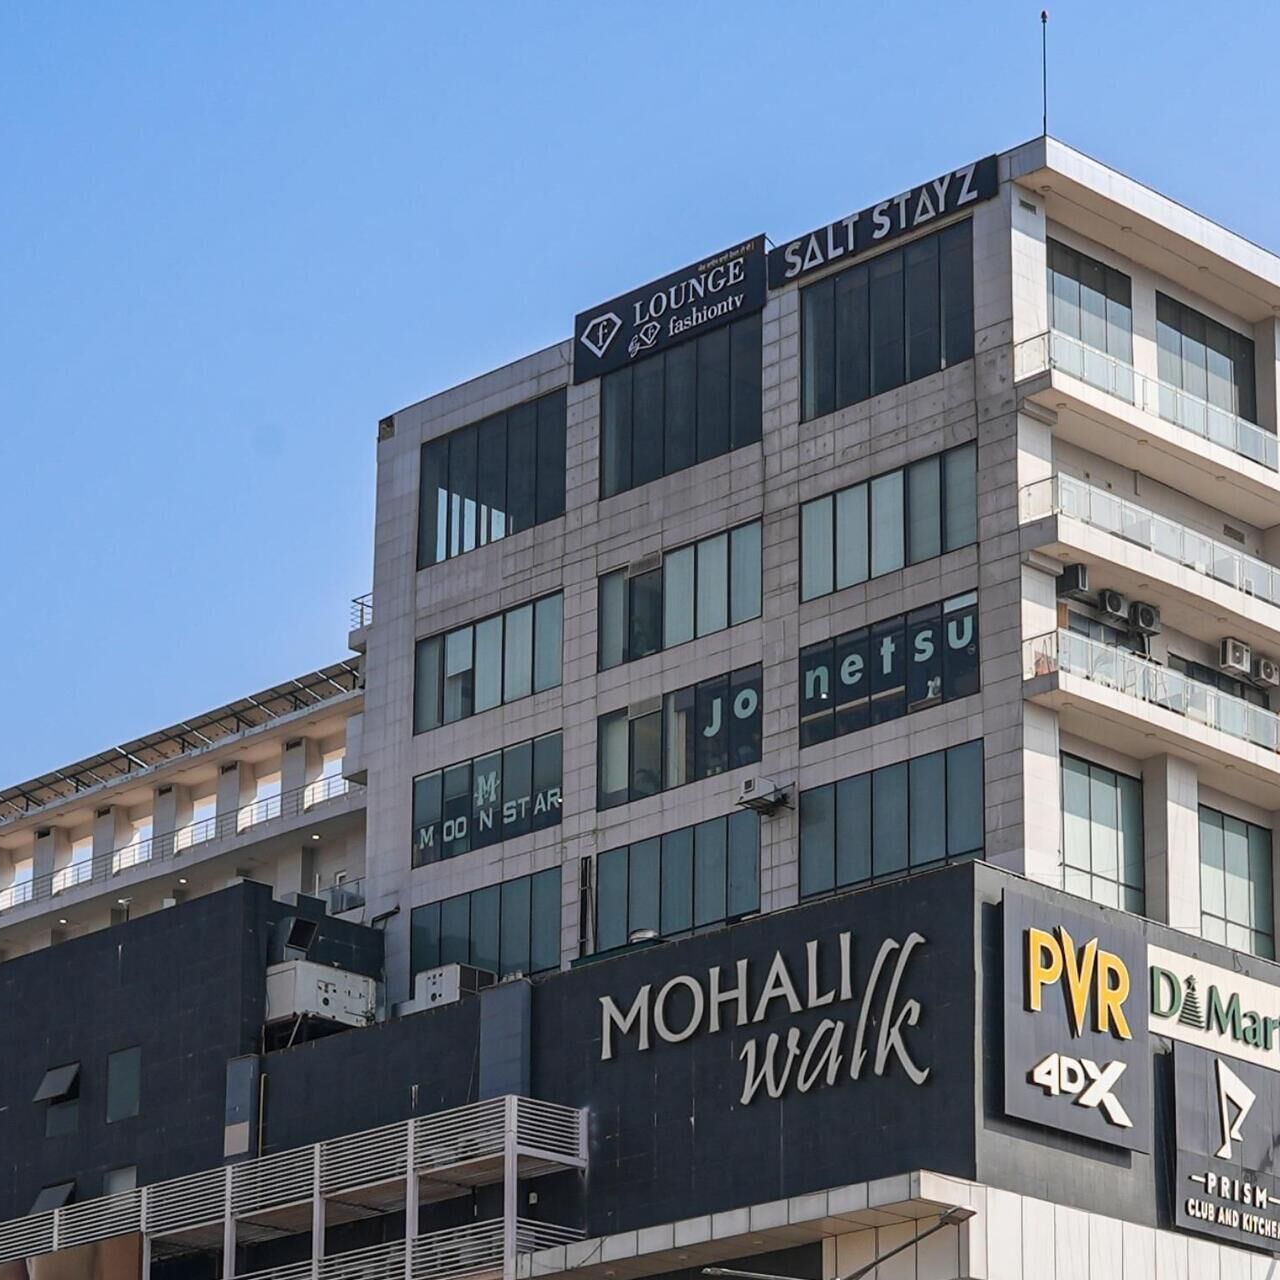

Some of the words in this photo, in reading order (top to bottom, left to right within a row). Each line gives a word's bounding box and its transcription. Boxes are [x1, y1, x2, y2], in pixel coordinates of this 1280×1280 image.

[784, 214, 860, 280] SALT
[872, 162, 979, 242] STAYZ
[632, 257, 745, 327] LOUNGE
[667, 293, 745, 337] fashiontv
[598, 931, 852, 1061] MOHALI
[738, 931, 931, 1106] walk
[1026, 925, 1132, 1041] PVR
[1027, 1052, 1133, 1128] 4DX
[1187, 1198, 1216, 1221] CLUB
[1218, 1206, 1240, 1228] AND
[1205, 1171, 1267, 1210] PRISM
